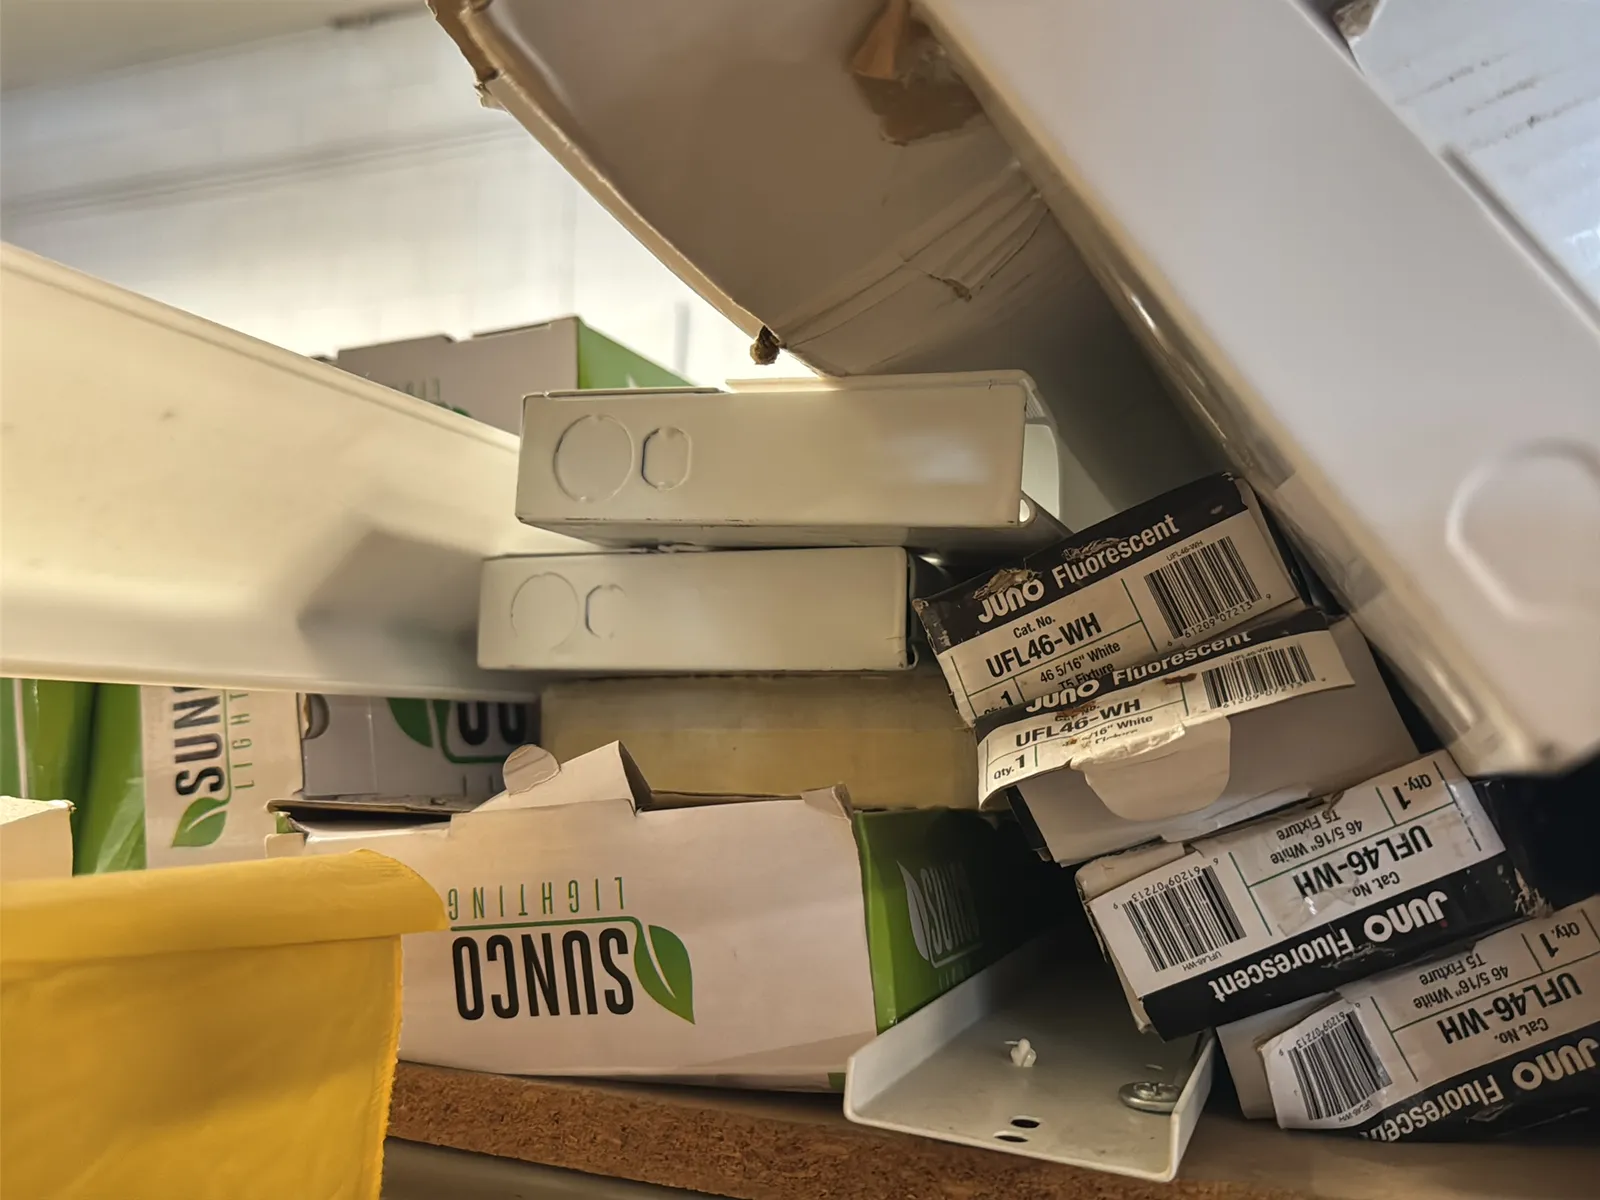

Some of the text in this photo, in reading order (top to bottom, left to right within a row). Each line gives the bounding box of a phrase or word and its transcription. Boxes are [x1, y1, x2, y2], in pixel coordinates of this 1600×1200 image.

[1052, 514, 1180, 589] Fluorescent
[1013, 614, 1056, 638] Cat. No.
[1184, 618, 1216, 638] 61209
[1220, 601, 1253, 622] 07213
[985, 612, 1102, 678] UFL46-WH
[1040, 641, 1121, 684] 46 5/16" White
[1112, 631, 1252, 686] Fluorescent
[1075, 662, 1115, 687] Fixture
[172, 686, 225, 796] SUN
[1016, 699, 1141, 747] UFL46-WH
[1117, 714, 1154, 730] White
[994, 754, 1025, 780] Qty. 1
[1392, 774, 1432, 810] Qty. 1
[1270, 819, 1363, 864] 46 5/16" White
[1276, 809, 1341, 841] T5 Fixture
[1168, 866, 1201, 886] 61209
[1292, 825, 1433, 898] UFL46-WH
[1371, 871, 1400, 890] Cat.
[447, 876, 625, 920] LIGHTING
[1131, 881, 1164, 902] 07213
[1539, 922, 1580, 958] Qty. 1
[452, 927, 634, 1020] SUNCO
[1208, 927, 1355, 1002] Fluorescent
[1419, 952, 1487, 986] T5 Fixture
[1413, 965, 1509, 1009] 46 5/16" White
[1436, 972, 1582, 1045] UFL46-WH
[1494, 1017, 1549, 1044] Cat. No.
[1360, 1074, 1504, 1143] Fluorescen
